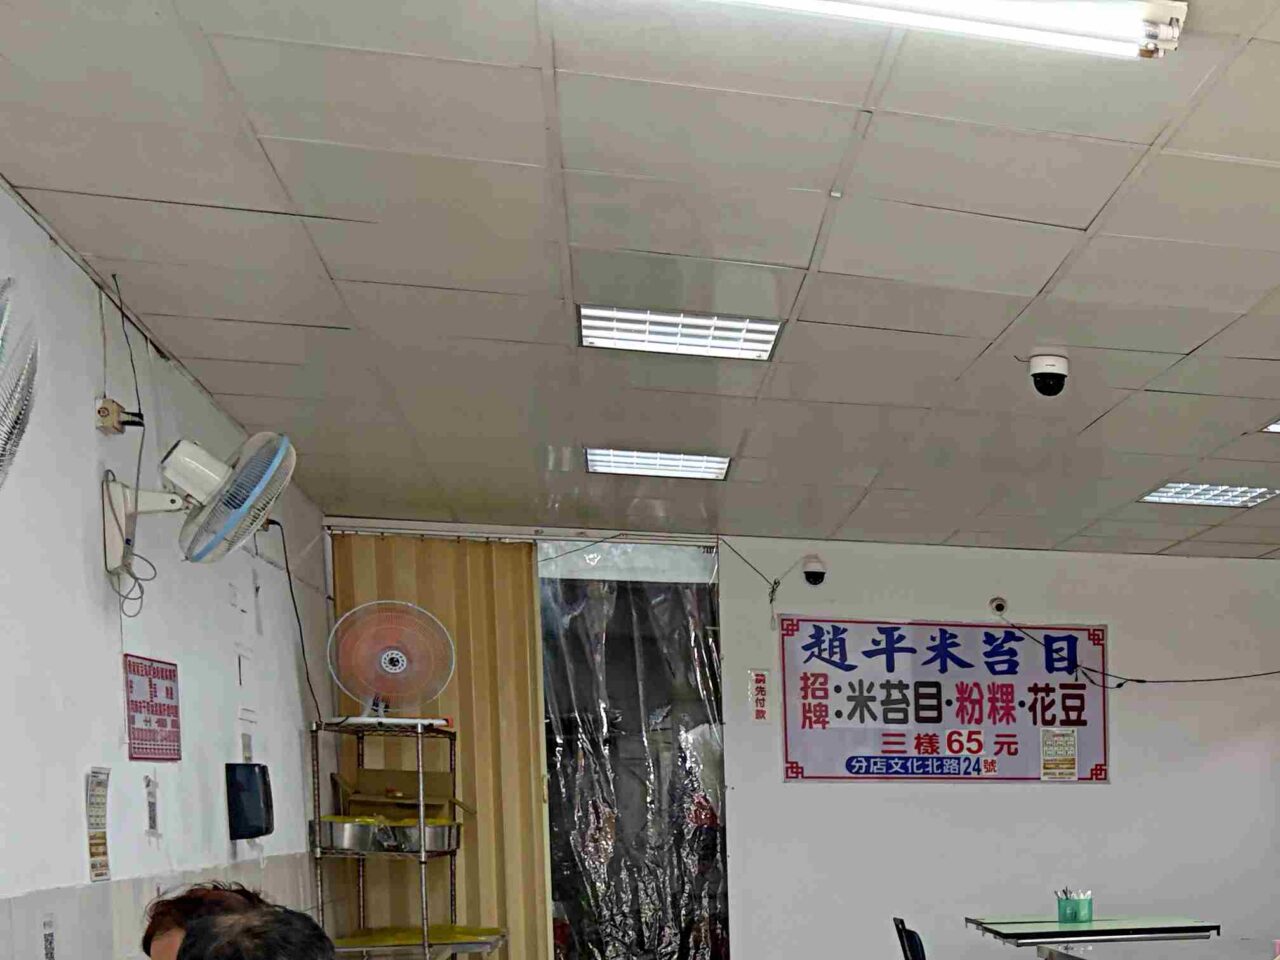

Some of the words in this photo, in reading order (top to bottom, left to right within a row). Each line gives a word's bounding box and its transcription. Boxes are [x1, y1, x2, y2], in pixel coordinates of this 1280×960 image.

[800, 623, 1080, 676] 趙平米苔目
[850, 756, 997, 775] 分店文化北路24號
